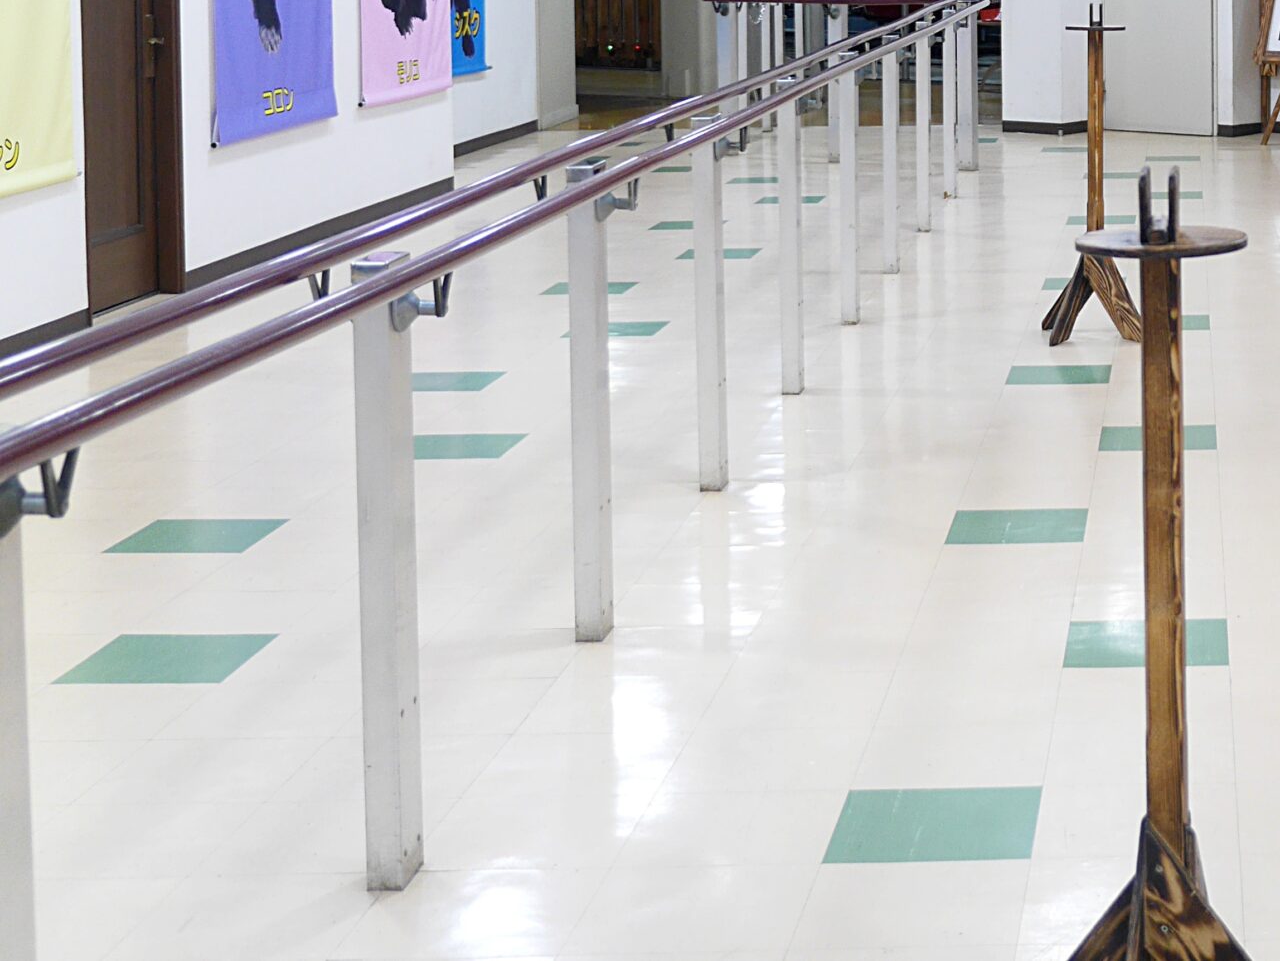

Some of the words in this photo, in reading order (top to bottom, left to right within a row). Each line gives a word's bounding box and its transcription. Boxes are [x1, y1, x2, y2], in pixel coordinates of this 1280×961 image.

[454, 7, 481, 40] シズク
[397, 59, 420, 84] モリコ
[262, 86, 294, 116] コロン
[0, 138, 20, 171] ン
